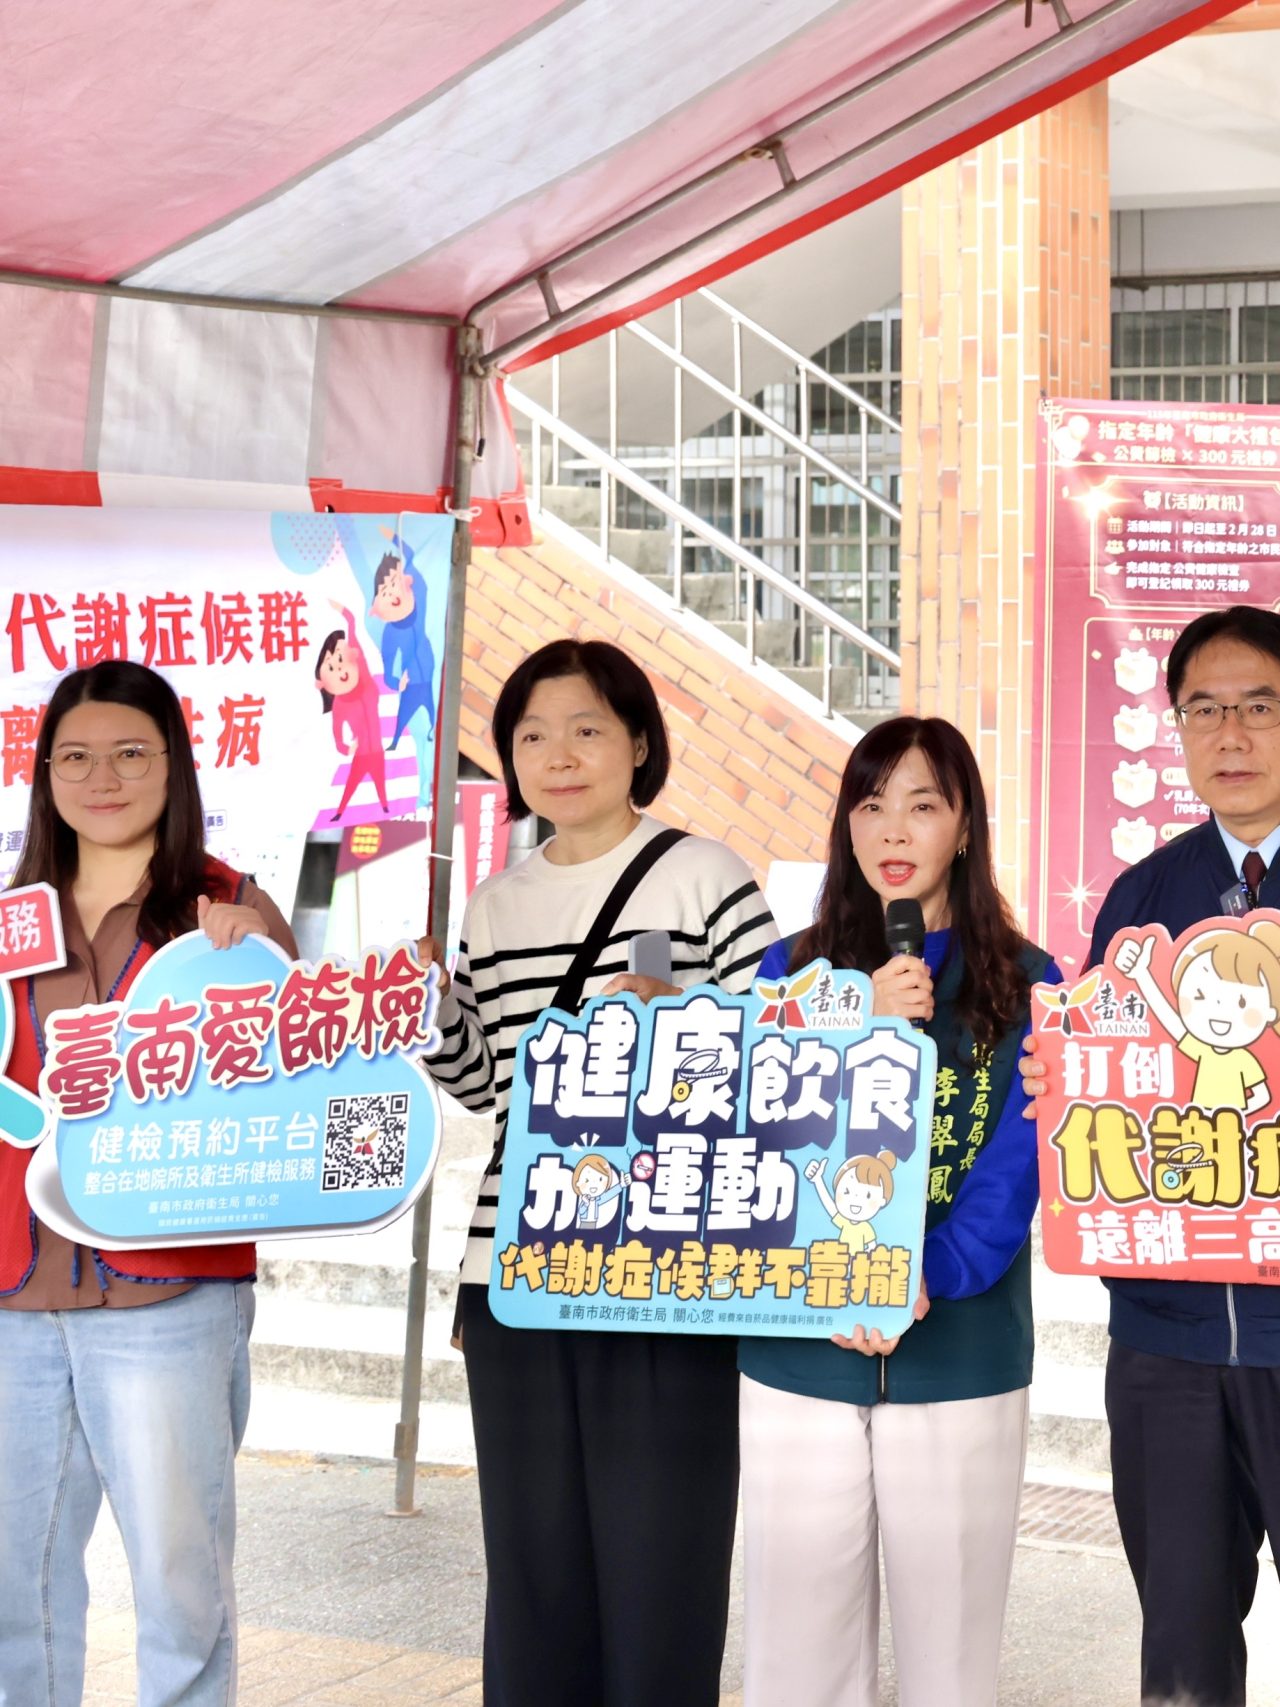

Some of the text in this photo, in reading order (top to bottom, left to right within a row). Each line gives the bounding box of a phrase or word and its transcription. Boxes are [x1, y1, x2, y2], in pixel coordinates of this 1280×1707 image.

[1199, 450, 1227, 463] 300
[1228, 524, 1235, 534] 2
[1238, 524, 1248, 536] 月
[1266, 525, 1277, 537] 日
[1195, 579, 1214, 590] 300
[5, 590, 310, 673] 代謝症候群
[808, 974, 863, 1014] 臺南
[1094, 984, 1146, 1021] 臺南
[47, 949, 431, 1116] 臺南愛篩檢
[809, 1016, 863, 1028] TAINAN
[1097, 1022, 1149, 1035] TAINAN
[528, 997, 921, 1134] 健康飲食
[1062, 1041, 1174, 1099] 打倒
[88, 1111, 319, 1165] 健檢預約平台
[927, 1067, 960, 1204] 李翠鳳
[83, 1157, 316, 1196] 整合在地院所及衛生所健檢服務
[521, 1133, 787, 1232] 加運動
[148, 1195, 240, 1214] 臺南市政府衛生局
[499, 1239, 911, 1309] 代謝症候群不靠攏
[558, 1303, 834, 1326] 臺南市政府衛生局 關心您 經費來自菸品健康福利捐 廣告
